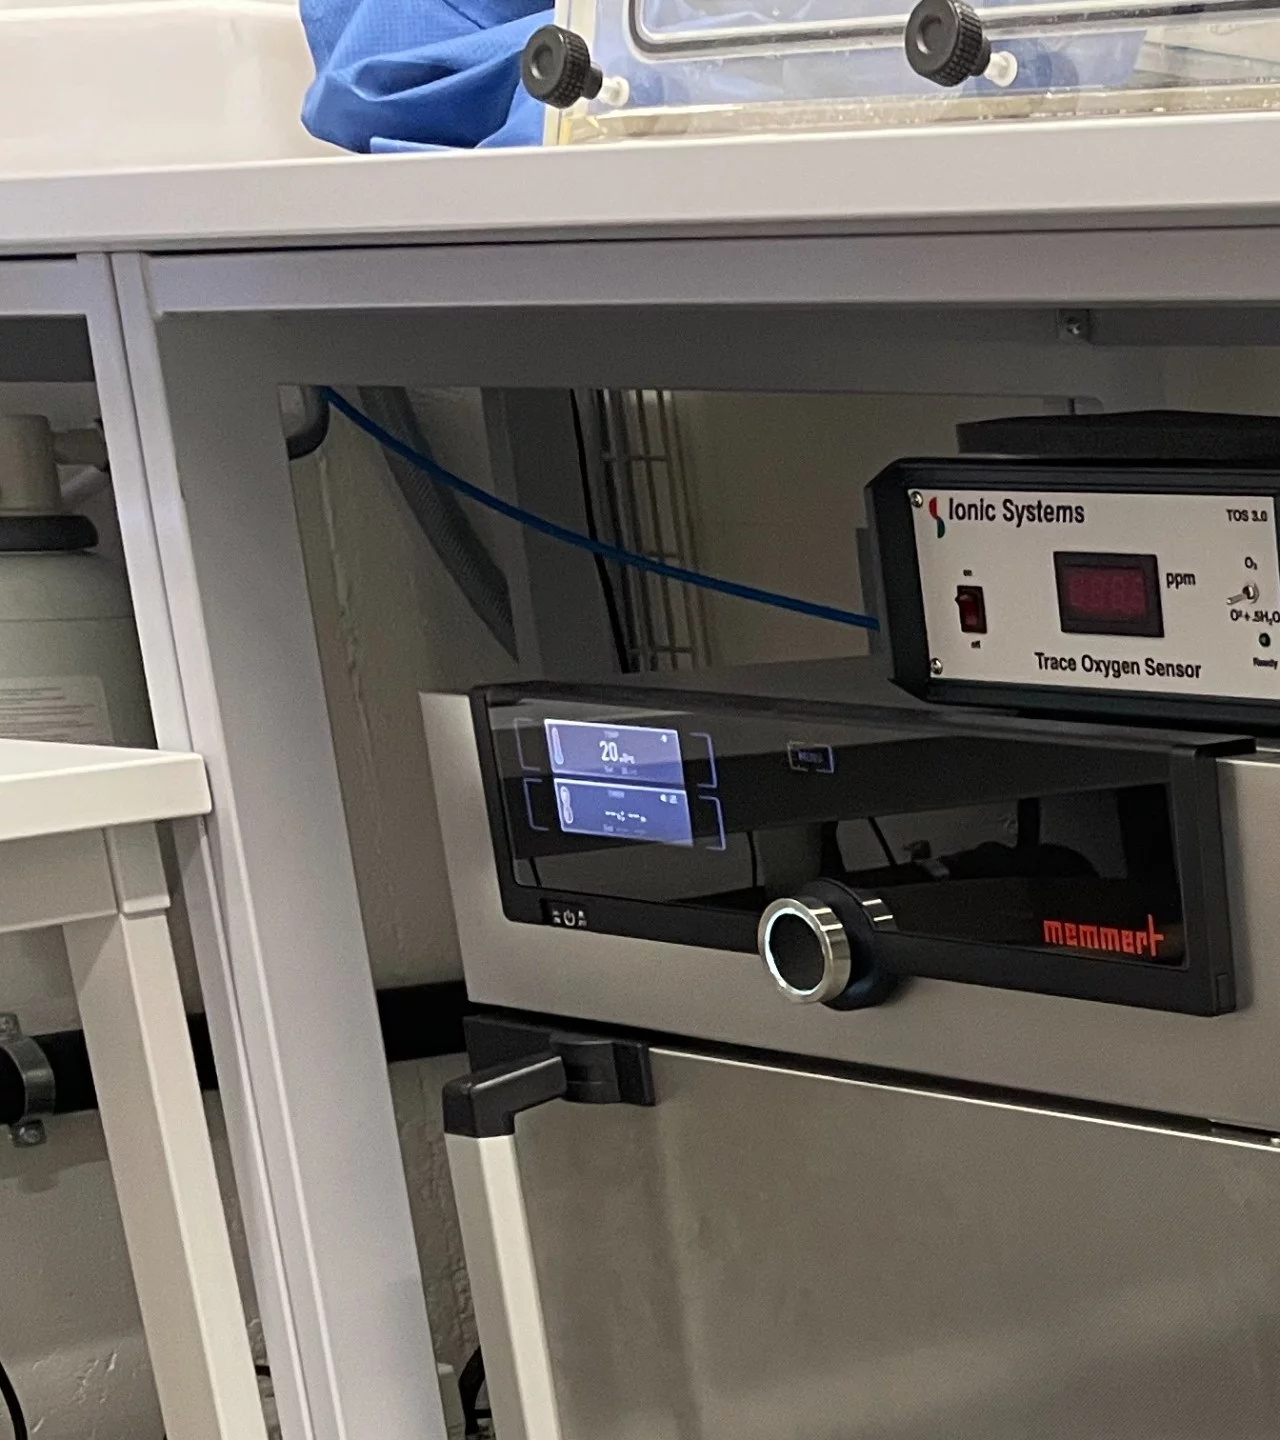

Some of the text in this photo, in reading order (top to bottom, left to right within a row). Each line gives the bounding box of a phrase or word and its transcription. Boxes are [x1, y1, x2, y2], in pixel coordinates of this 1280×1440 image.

[948, 498, 1085, 529] Ionic Systems
[1226, 509, 1268, 522] TOS 3.0
[1166, 572, 1196, 589] ppm
[1034, 652, 1202, 679] Trace Oxygen Sensor
[1043, 913, 1165, 957] memmert
